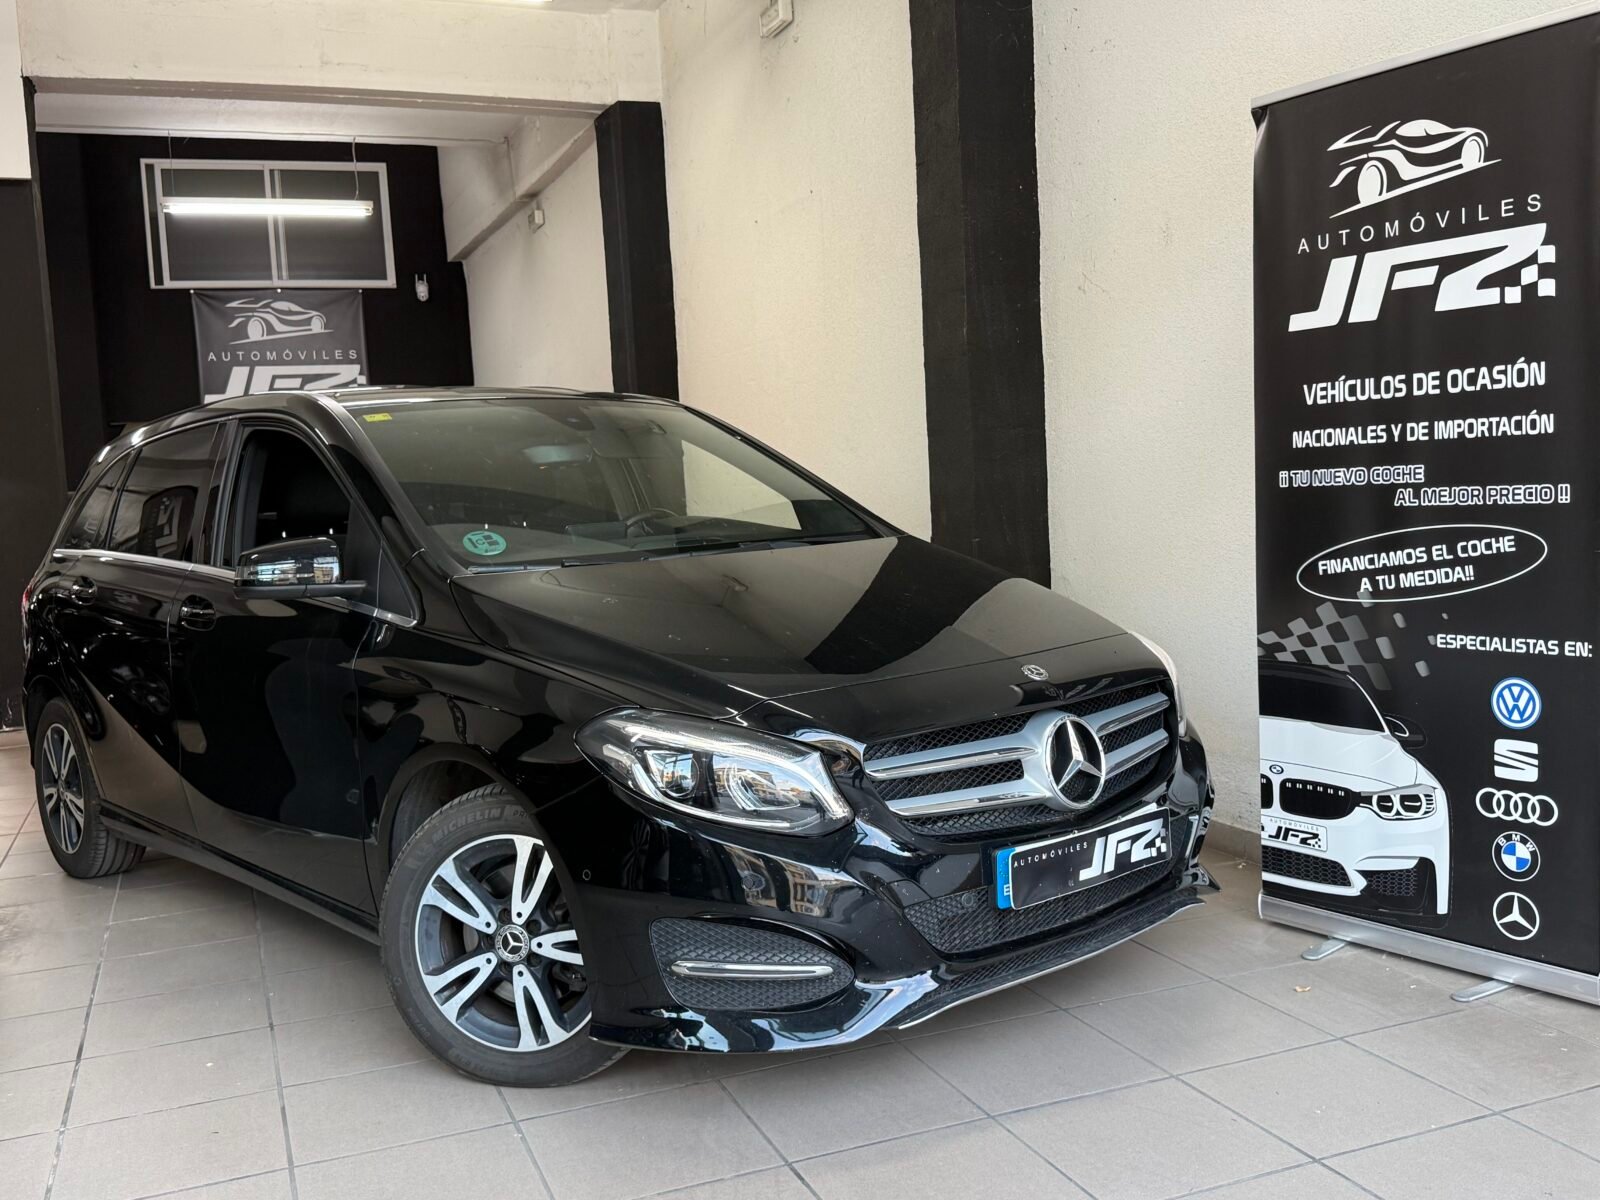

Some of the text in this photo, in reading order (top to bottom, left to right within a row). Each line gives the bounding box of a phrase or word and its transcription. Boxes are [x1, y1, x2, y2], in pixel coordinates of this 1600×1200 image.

[1297, 193, 1542, 255] AUTOMÓVILES
[1288, 222, 1547, 332] JFZ
[207, 348, 358, 362] AUTOMÓVILES
[1303, 356, 1546, 405] VEHÍCULOS DE OCASIÓN
[1292, 409, 1554, 448] NACIONALES Y DE IMPORTACIÓN
[1290, 470, 1310, 487] TU
[1312, 467, 1367, 486] NUEVO
[1370, 465, 1424, 483] COCHE
[1394, 488, 1419, 506] AL
[1421, 486, 1483, 505] MEJOR
[1486, 484, 1554, 504] PRECIO
[1318, 535, 1516, 575] FINANCIAMOS EL COCHE
[1359, 565, 1474, 592] A TU MEDIDA!!
[1436, 634, 1593, 657] ESPECIALISTAS EN:
[1079, 818, 1166, 881] JFZ
[1268, 825, 1320, 847] JFZ
